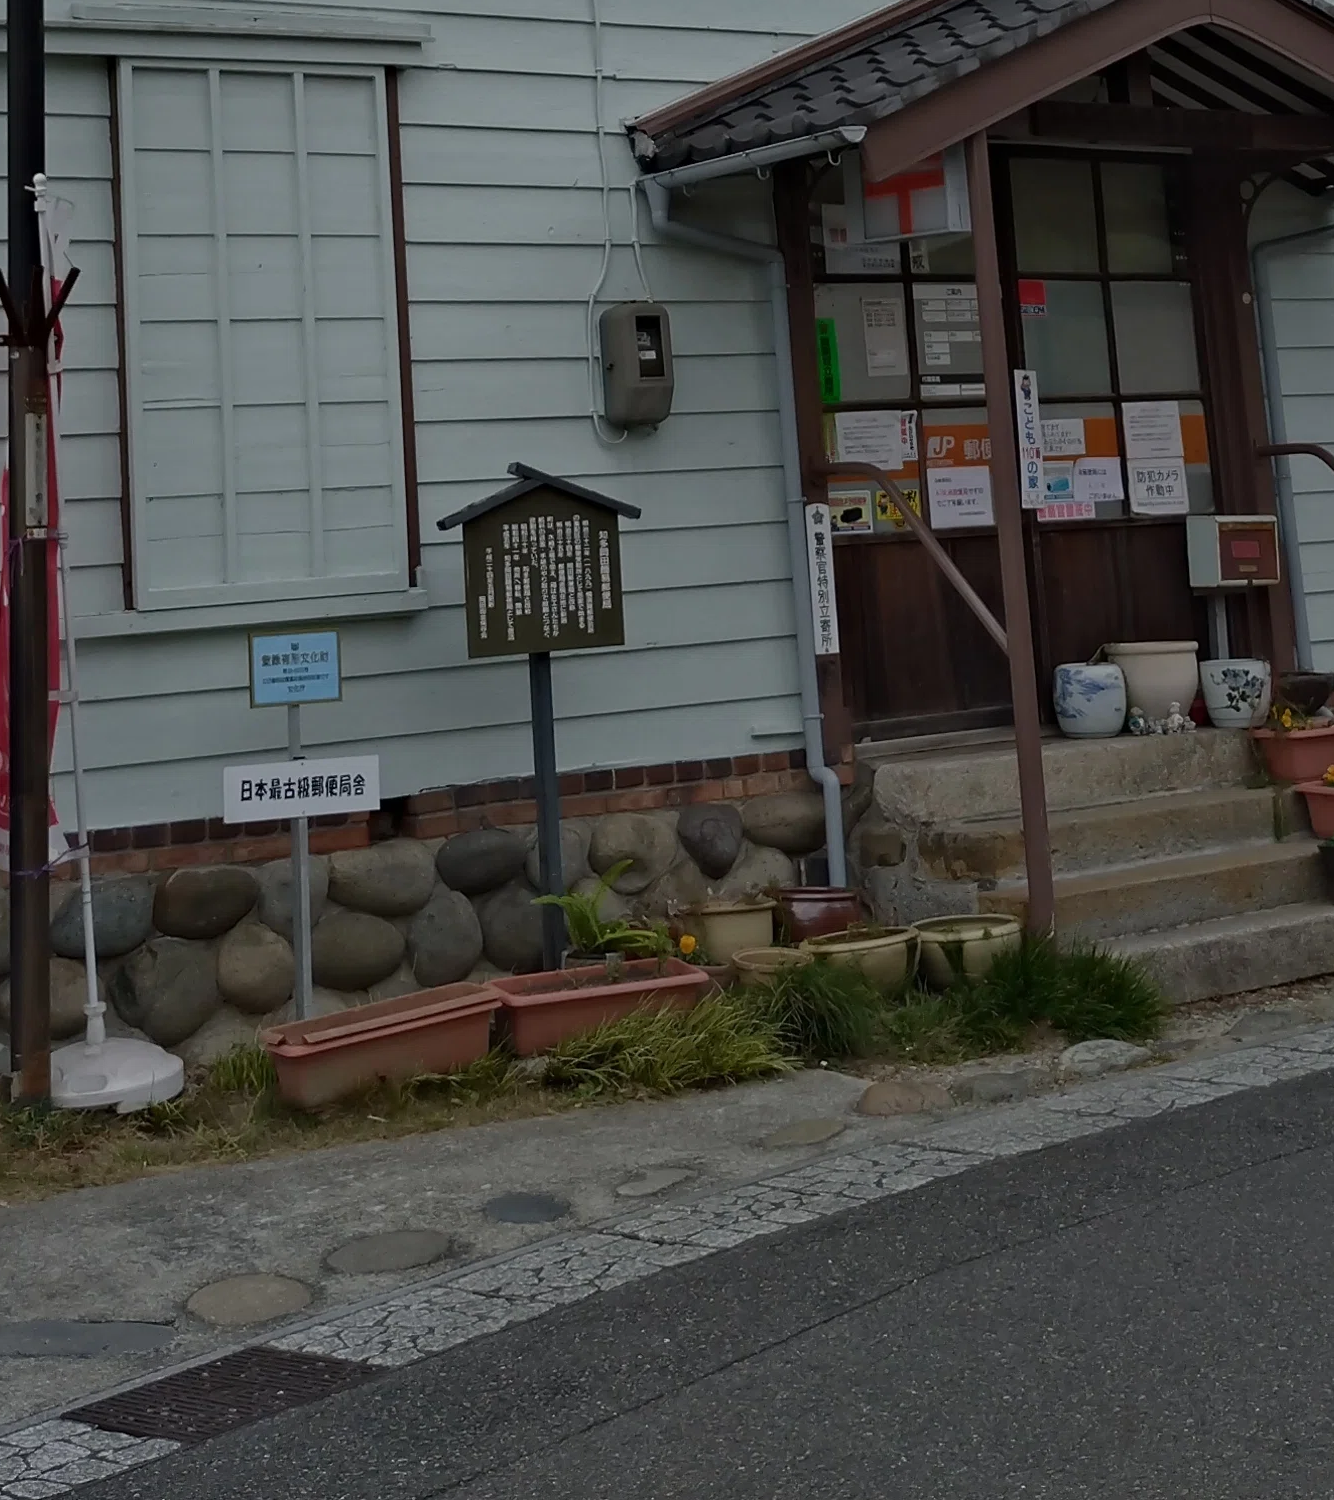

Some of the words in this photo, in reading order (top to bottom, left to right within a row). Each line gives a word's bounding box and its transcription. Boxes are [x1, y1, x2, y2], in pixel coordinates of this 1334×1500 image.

[927, 435, 955, 458] JP
[1136, 469, 1179, 483] 防犯カメラ
[1145, 483, 1174, 497] 作動中
[240, 774, 366, 802] 日本最古級郵便局舎
